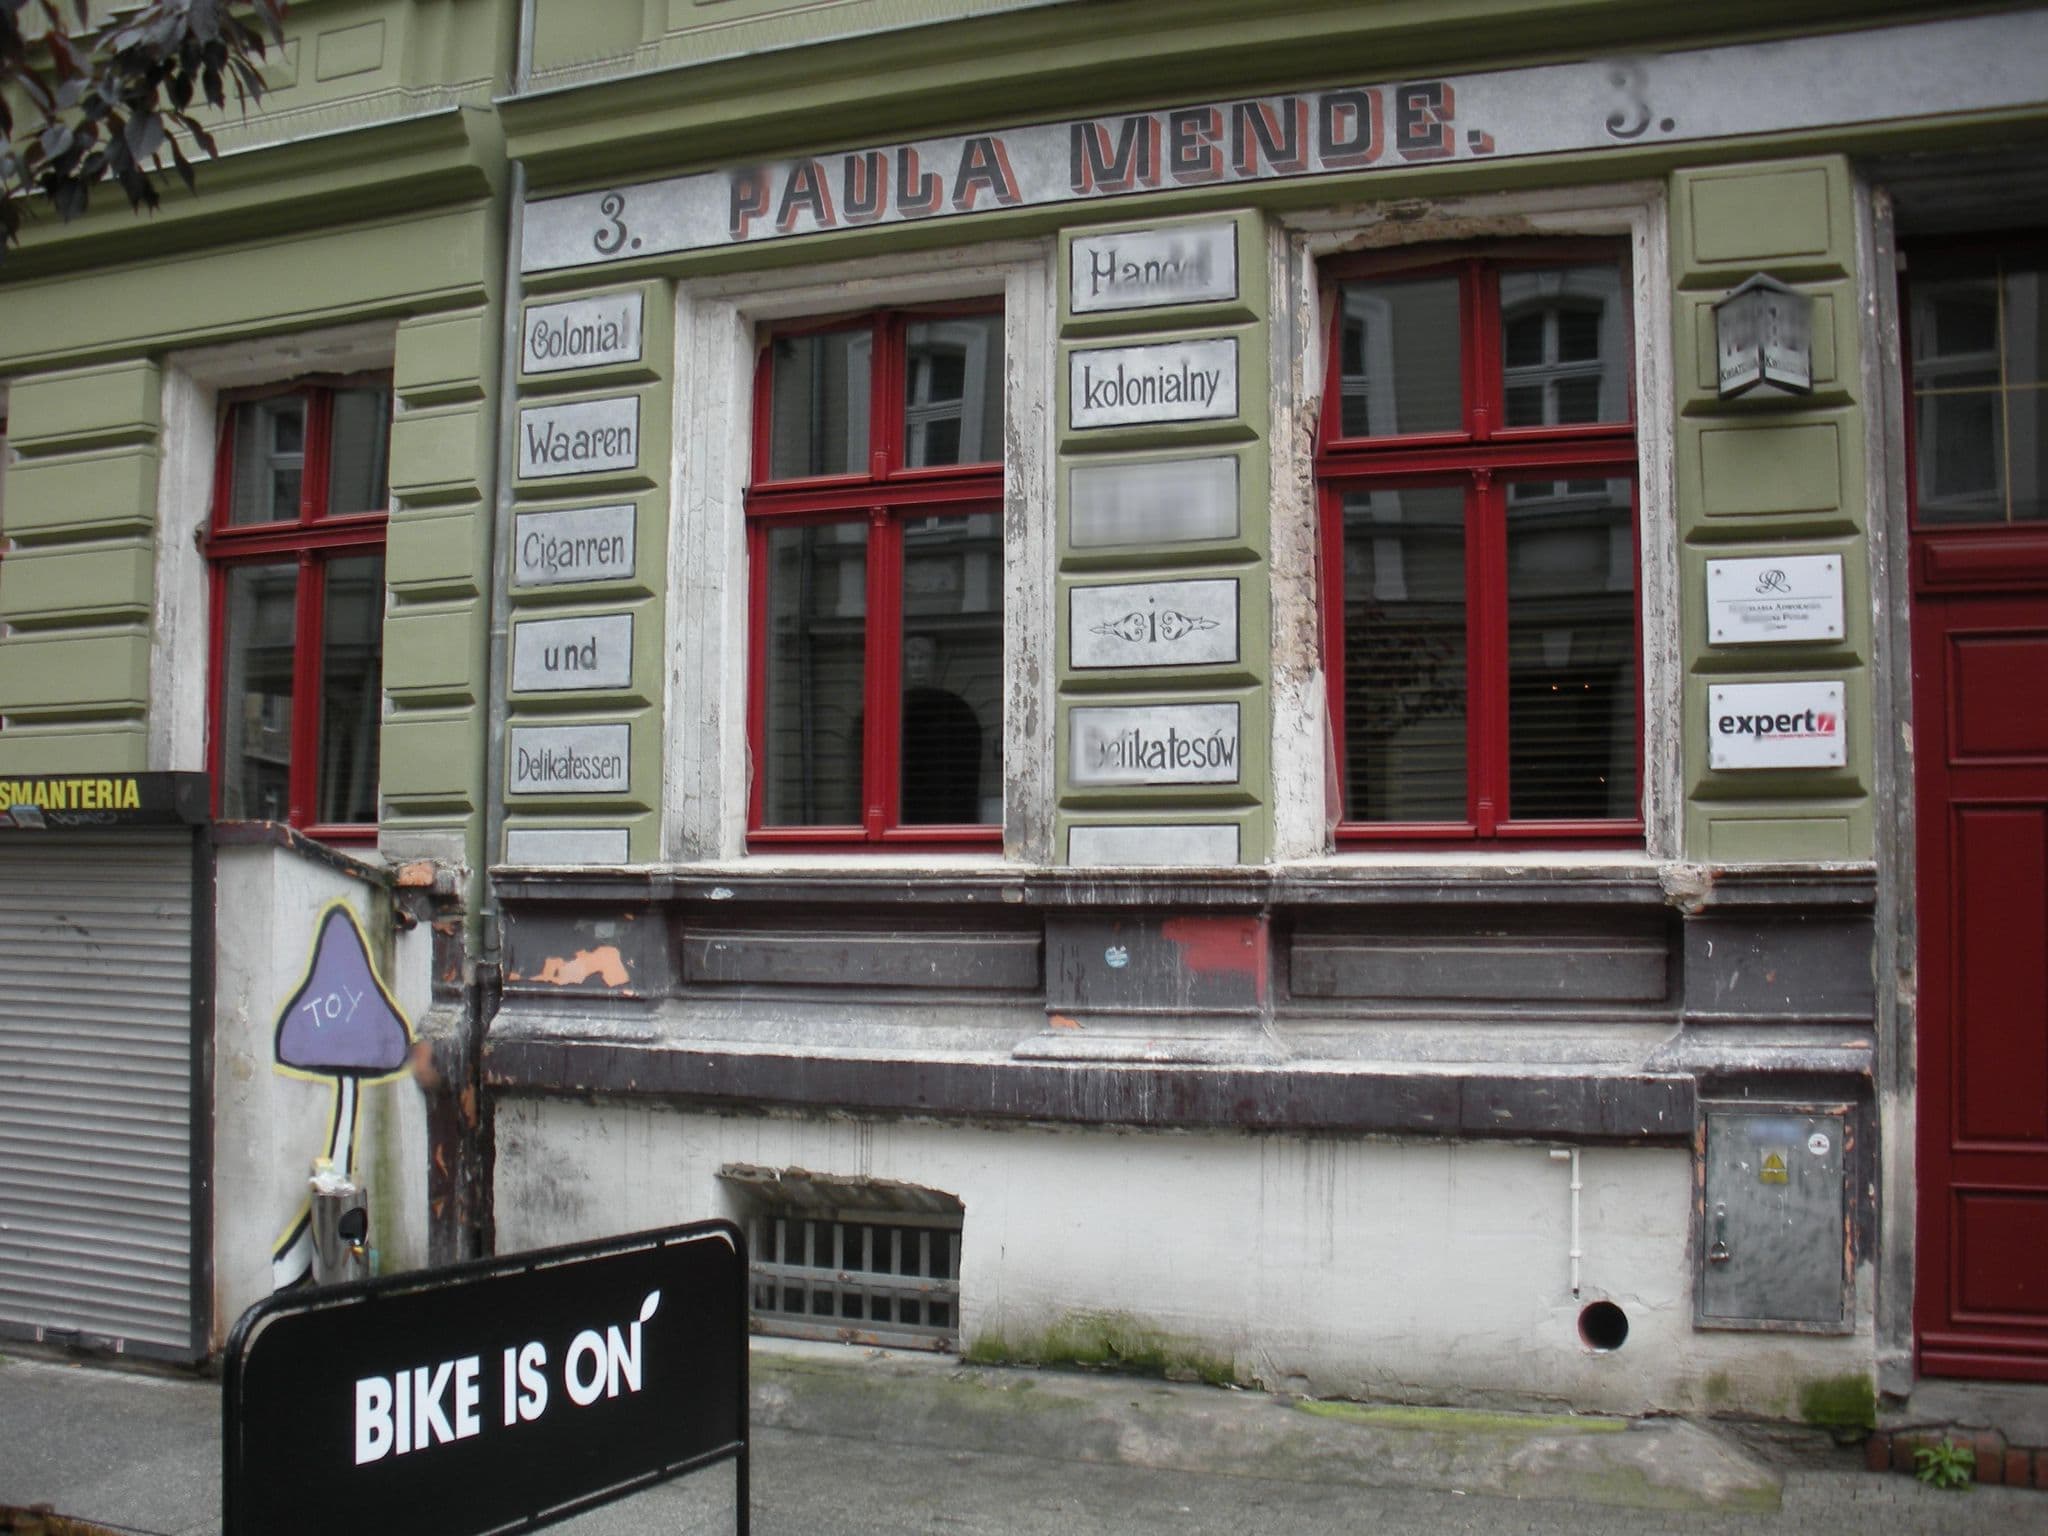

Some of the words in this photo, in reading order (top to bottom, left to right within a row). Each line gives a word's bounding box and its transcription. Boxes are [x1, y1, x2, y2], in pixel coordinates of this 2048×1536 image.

[594, 192, 642, 255] 3.
[1070, 80, 1496, 197] MENDE.
[1083, 358, 1220, 410] kolonialny
[526, 421, 632, 465] Waaren
[523, 532, 625, 575] Cigarren
[543, 637, 599, 671] und
[517, 746, 622, 783] Delikatessen
[302, 984, 364, 1028] TOY
[355, 1354, 481, 1466] BIKE
[503, 1340, 549, 1427] IS
[564, 1320, 643, 1407] ON
